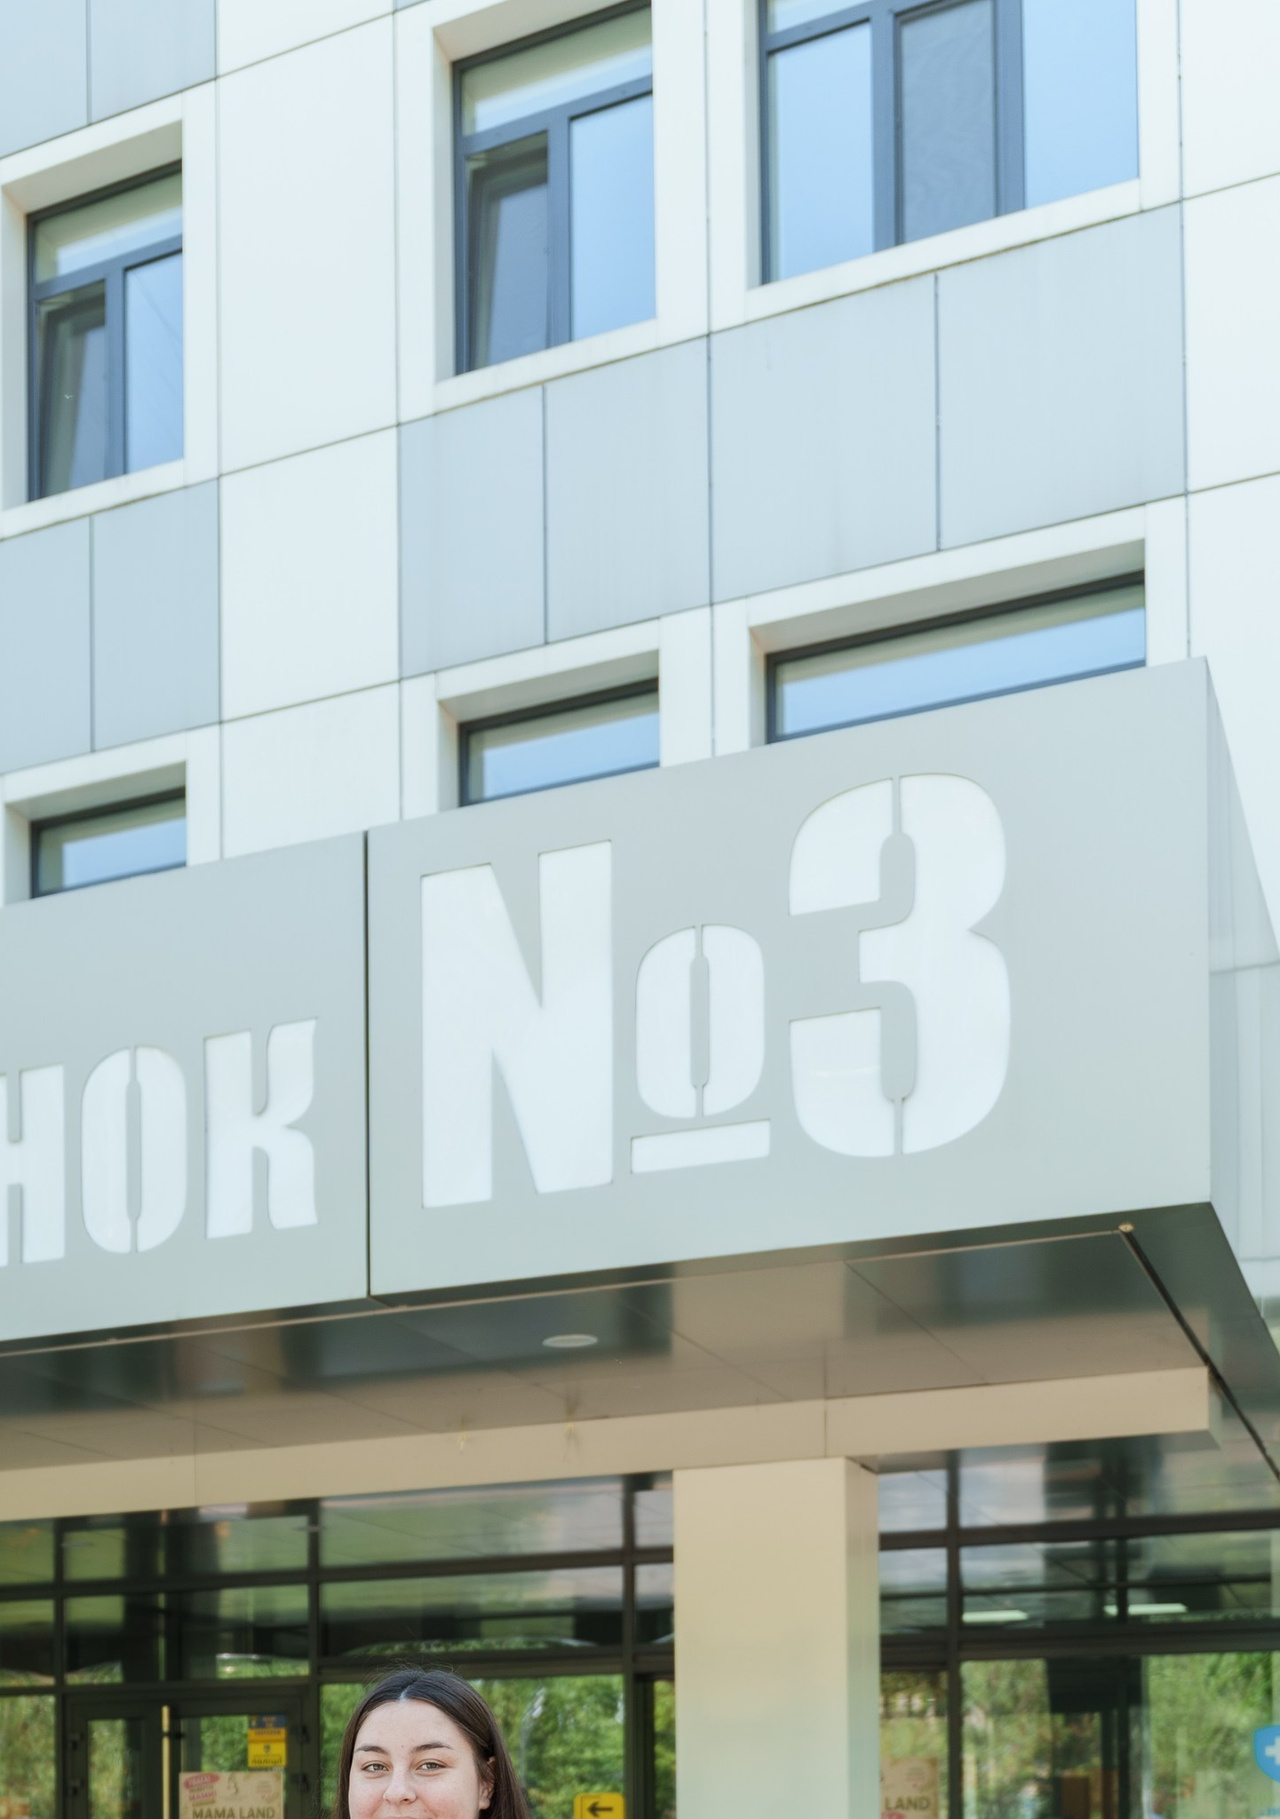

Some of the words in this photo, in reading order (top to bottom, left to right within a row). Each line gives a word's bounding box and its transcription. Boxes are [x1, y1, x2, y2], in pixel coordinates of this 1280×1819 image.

[884, 1795, 931, 1811] LAND
[192, 1807, 235, 1819] MAMA
[239, 1806, 275, 1819] LAND
